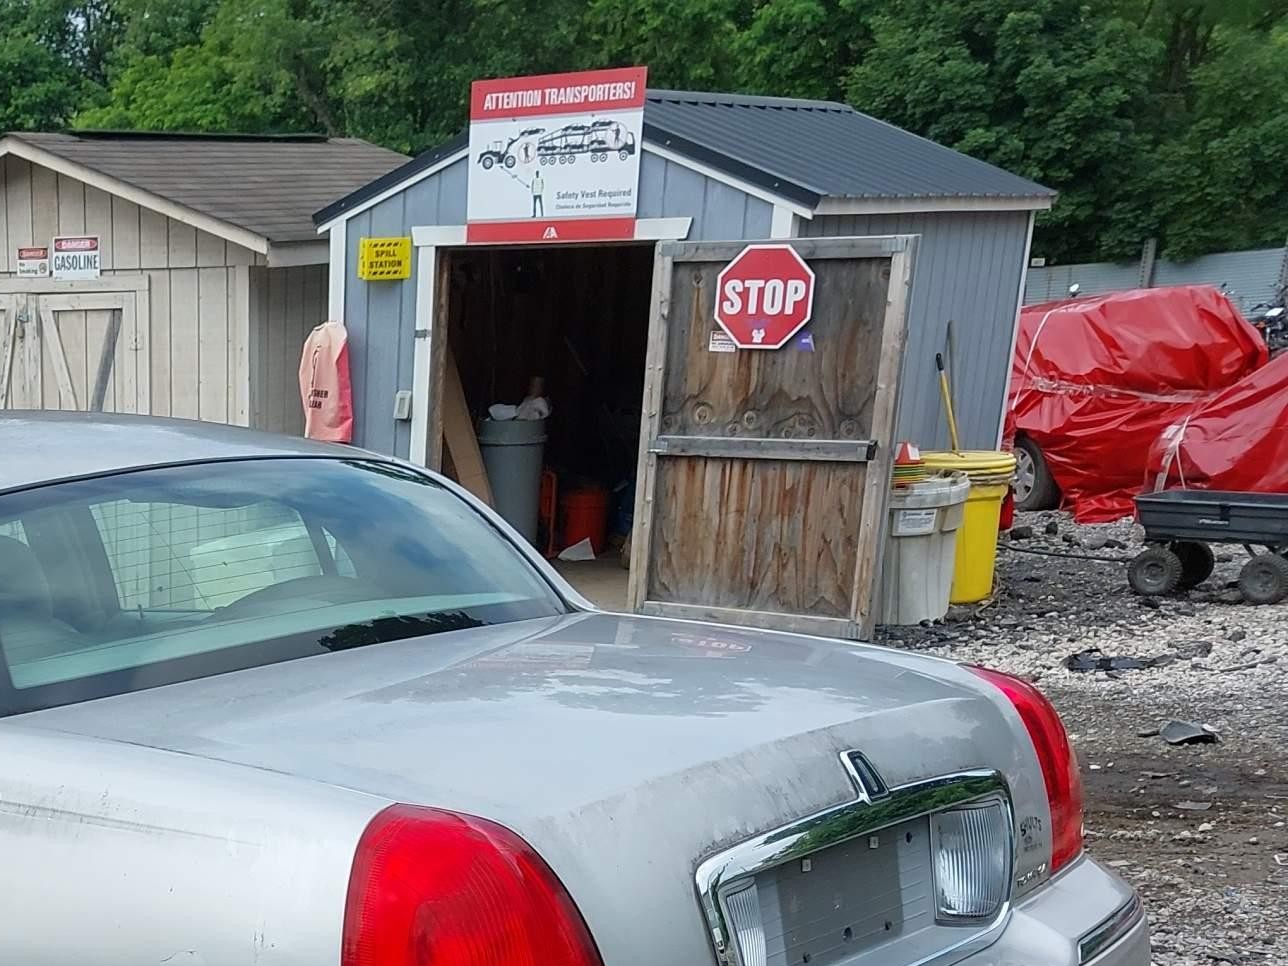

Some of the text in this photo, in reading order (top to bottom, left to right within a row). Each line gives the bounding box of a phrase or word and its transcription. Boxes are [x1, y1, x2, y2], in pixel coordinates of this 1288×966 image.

[484, 81, 635, 111] ATTENTION TRANSPORTERS!
[556, 188, 632, 200] Safety Vest Required
[375, 249, 397, 258] SPILL
[54, 255, 98, 271] GASOLINE
[369, 260, 402, 269] STATION
[722, 279, 806, 315] STOP
